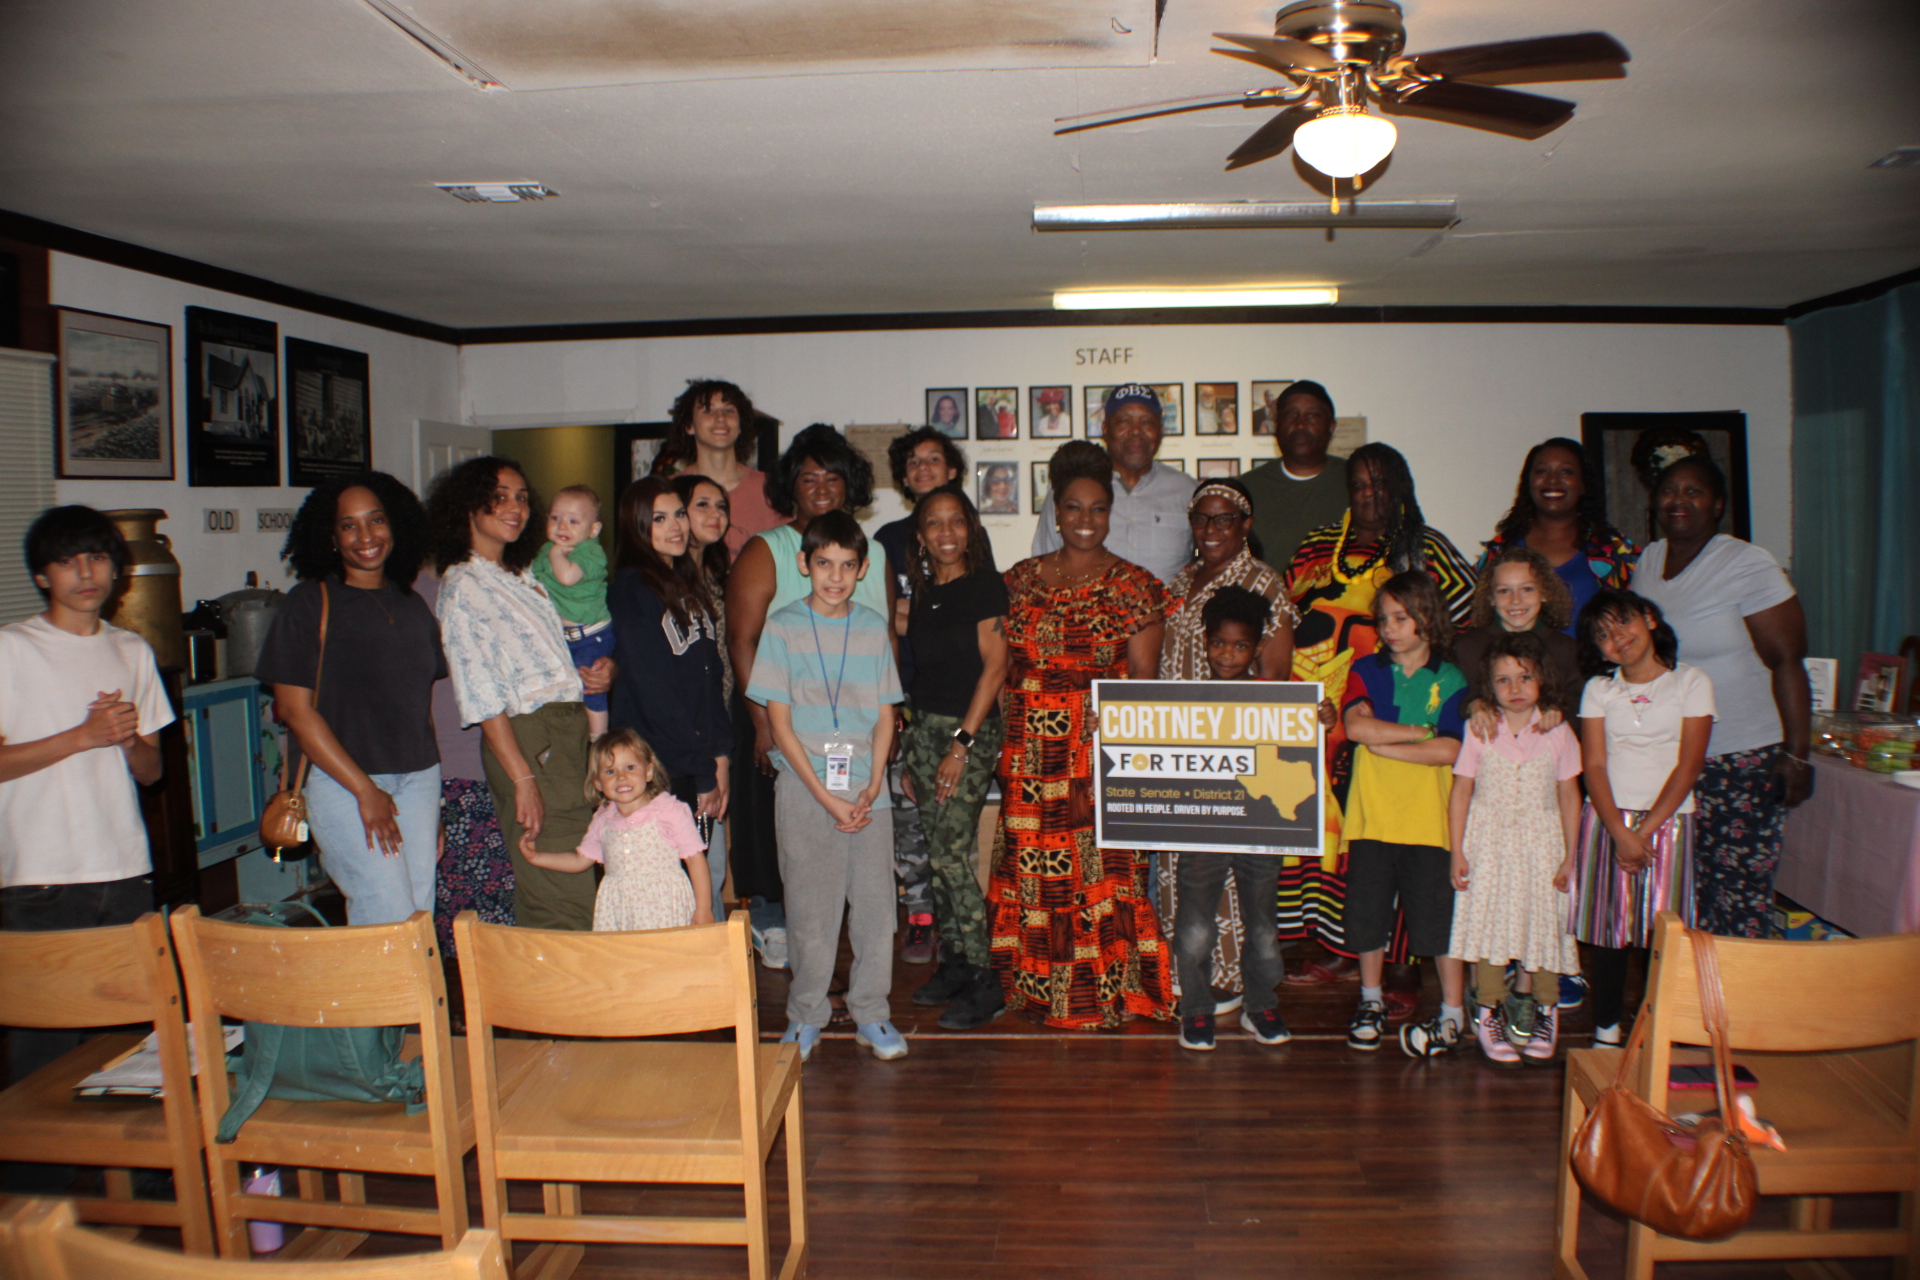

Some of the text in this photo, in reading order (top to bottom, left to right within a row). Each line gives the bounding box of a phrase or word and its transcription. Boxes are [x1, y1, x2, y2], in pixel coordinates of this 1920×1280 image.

[1075, 347, 1134, 366] STAFF
[208, 510, 295, 531] OLD SCHOO
[1102, 705, 1315, 742] CORTNEY JONES
[1120, 753, 1250, 773] FOR TEXAS
[1106, 786, 1245, 801] State Senate District 21
[1106, 802, 1248, 817] ROOTED IN PEOPLE. DRIVEN BY PURPOSE.
